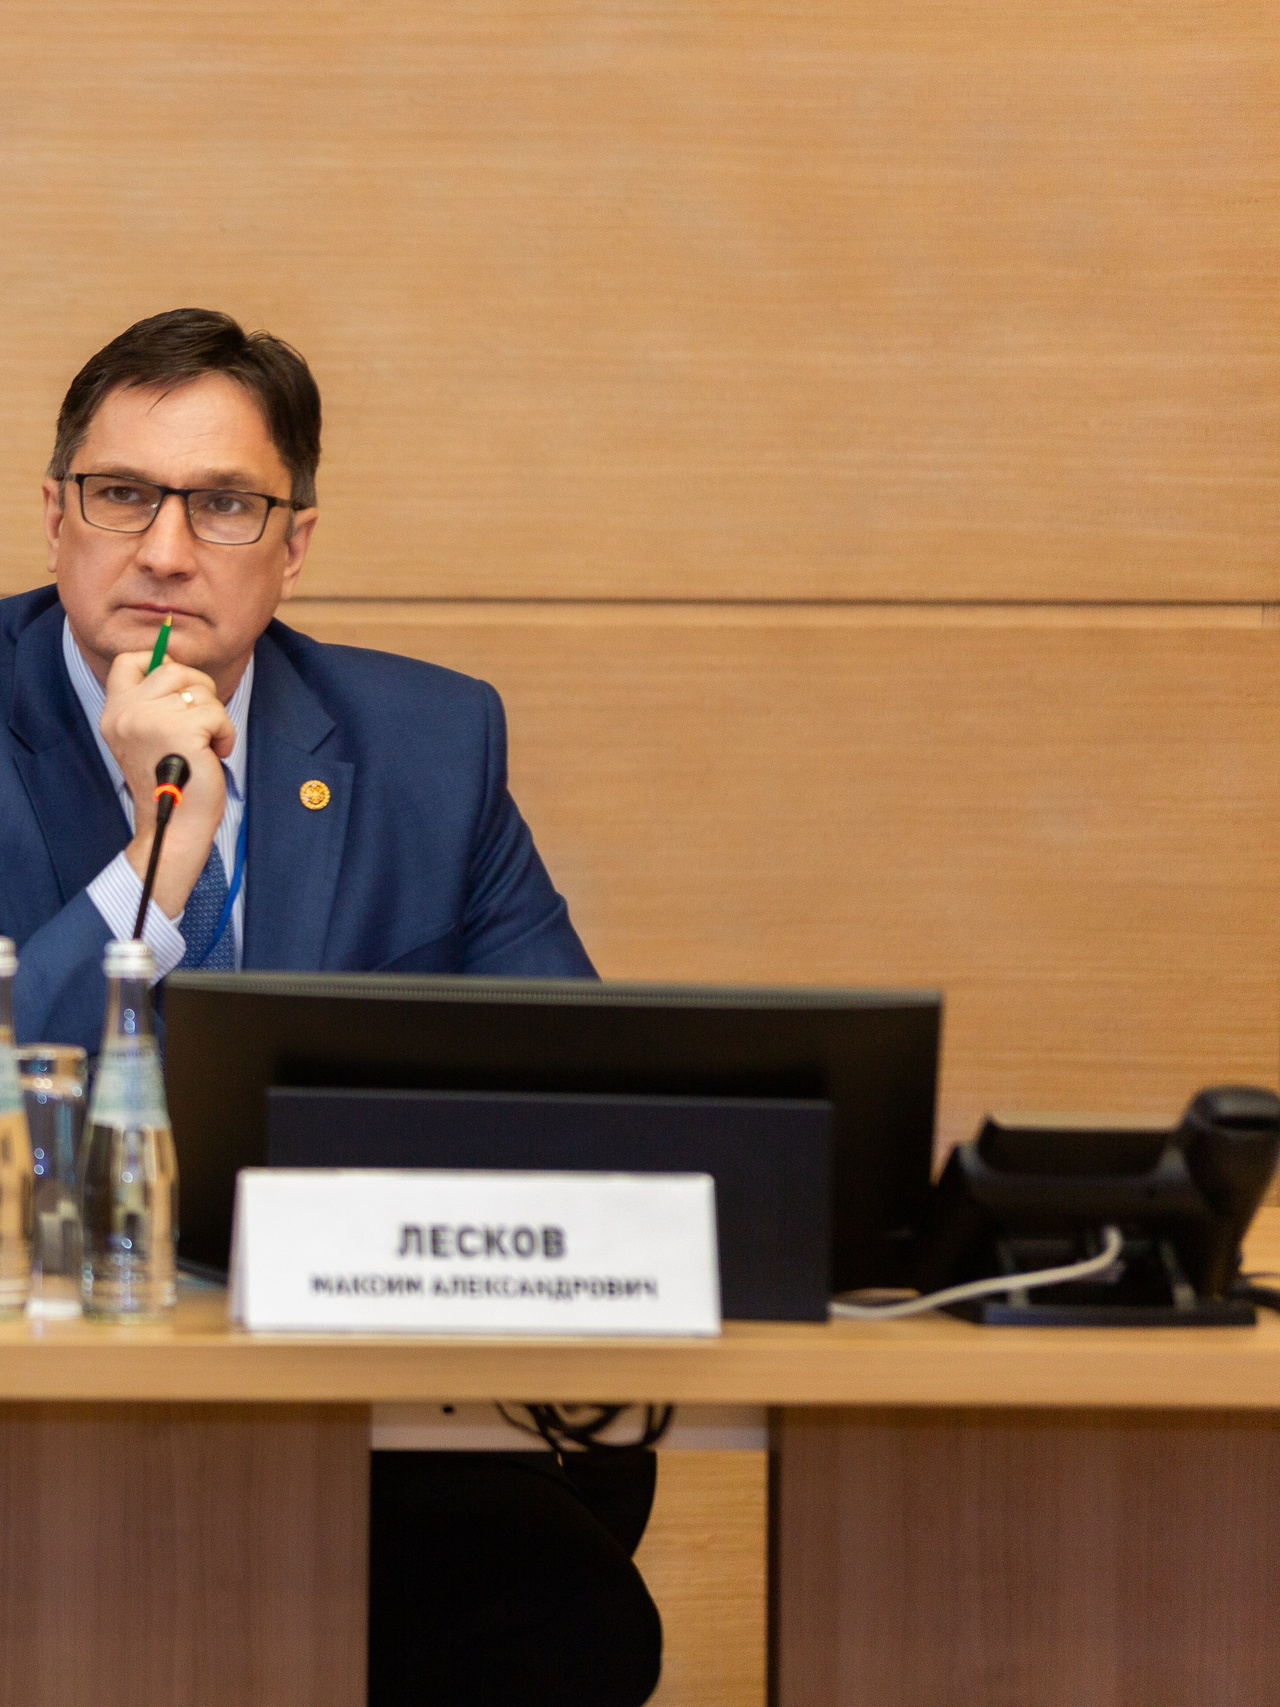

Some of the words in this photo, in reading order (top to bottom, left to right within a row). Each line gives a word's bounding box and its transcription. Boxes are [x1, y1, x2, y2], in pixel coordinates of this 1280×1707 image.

[396, 1223, 567, 1261] ЛЕСКОВ
[311, 1275, 424, 1297] МАКСИМ
[431, 1275, 658, 1302] АЛЕКСАНДРОВИЧ
